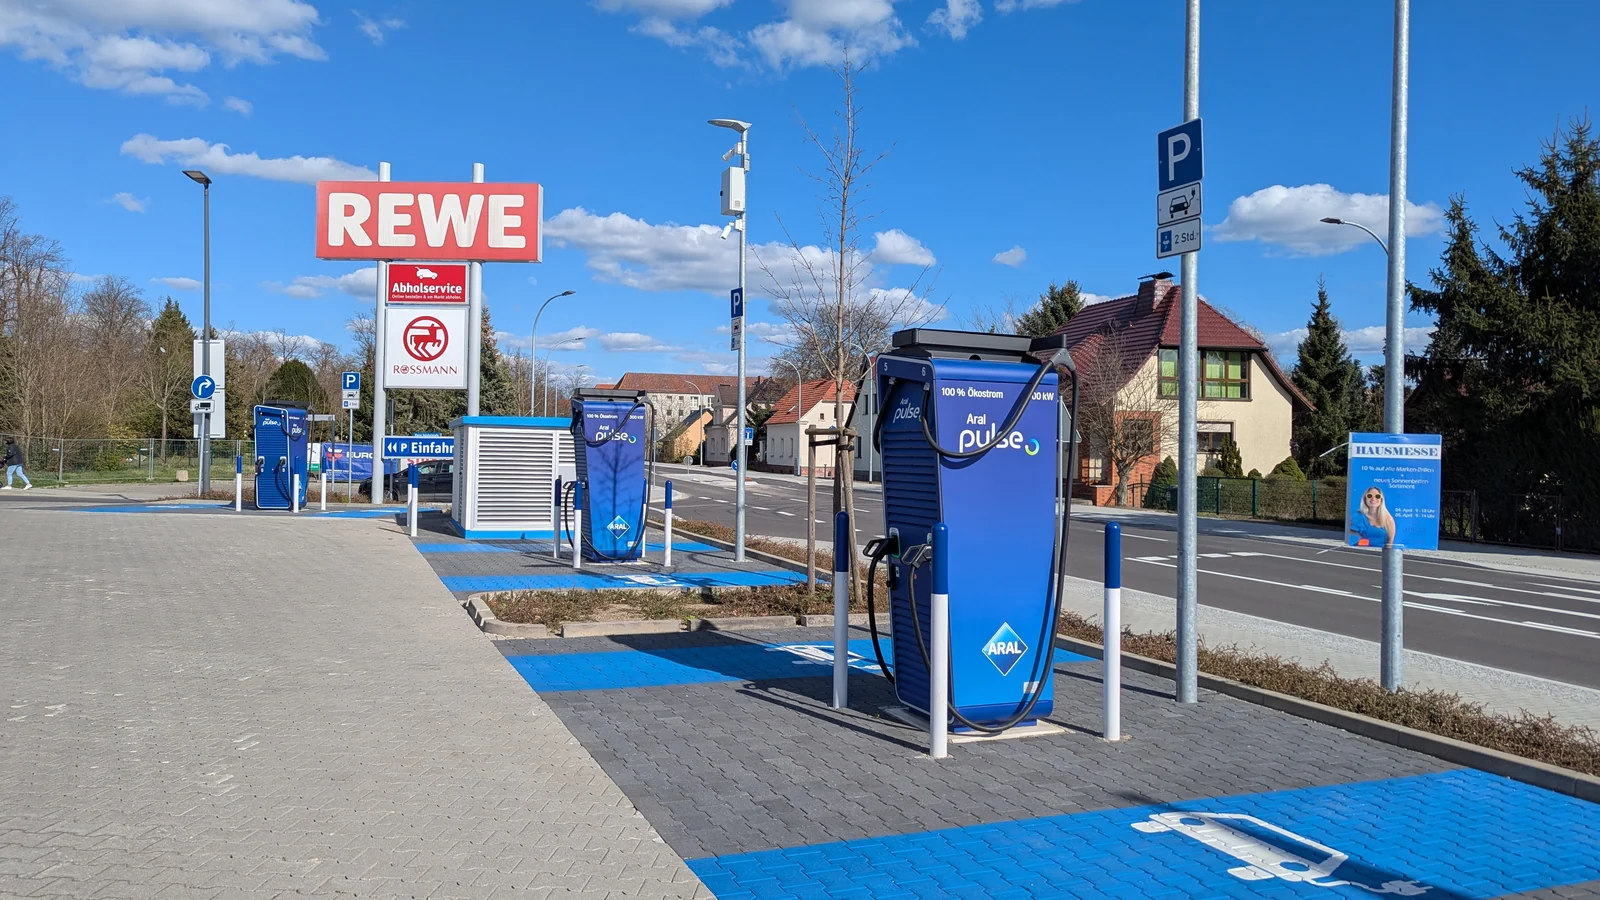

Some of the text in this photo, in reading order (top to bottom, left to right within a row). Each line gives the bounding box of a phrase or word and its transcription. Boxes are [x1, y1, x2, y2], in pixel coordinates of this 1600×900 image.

[1168, 132, 1191, 181] P
[328, 192, 526, 249] REWE
[1174, 230, 1197, 245] 2 Std.
[392, 282, 463, 294] Abholservice
[733, 292, 740, 315] P
[393, 364, 458, 375] ROSSMANN
[884, 362, 888, 372] 5
[922, 366, 926, 376] 6
[346, 374, 356, 388] P
[941, 386, 1004, 399] 100 % Ökostrom
[1031, 392, 1054, 401] 00 kW
[892, 402, 920, 424] pulse
[966, 412, 986, 425] Aral
[401, 442, 454, 454] P Einfahr
[1356, 446, 1438, 456] HAUSMESSE
[988, 640, 1022, 655] ARAL
